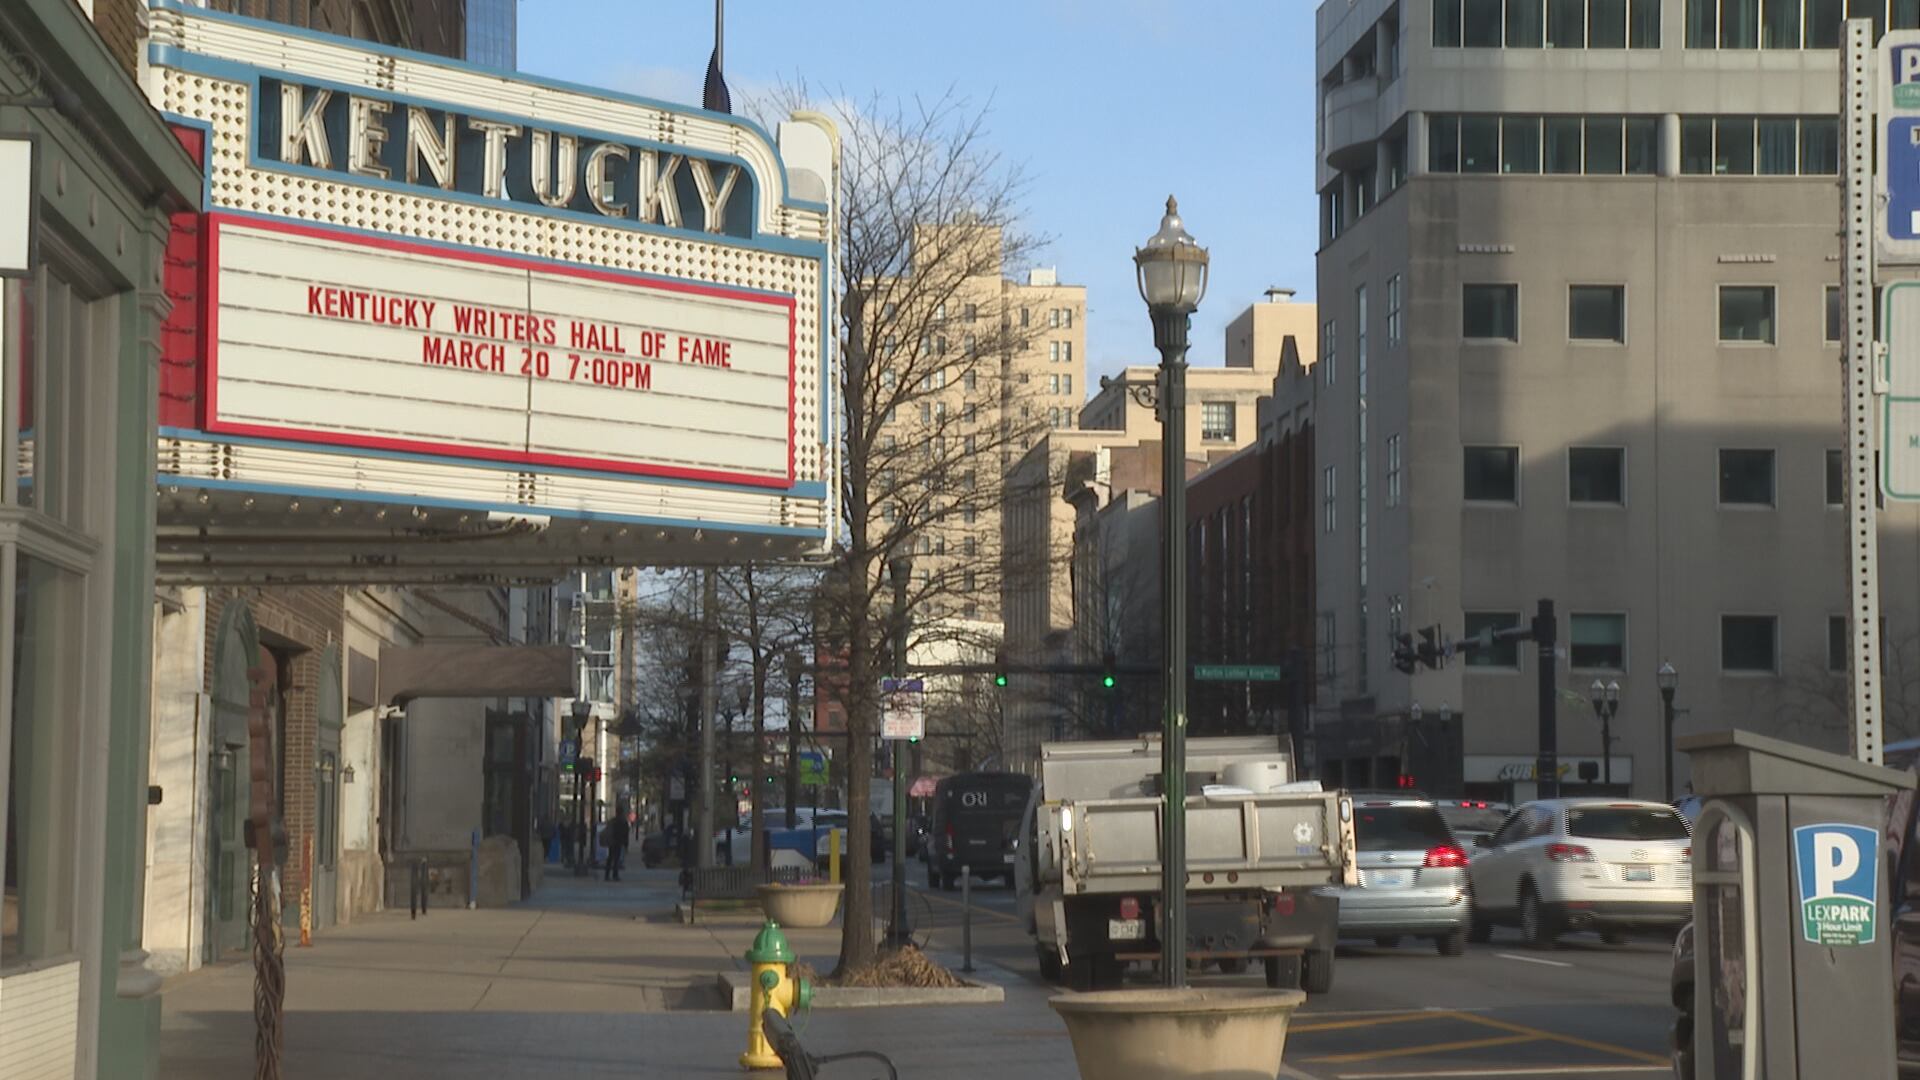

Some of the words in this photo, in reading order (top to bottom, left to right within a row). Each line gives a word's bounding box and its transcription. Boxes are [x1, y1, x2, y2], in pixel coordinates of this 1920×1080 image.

[280, 83, 742, 235] KENTUCKY
[306, 286, 436, 331] KENTUCKY
[452, 304, 558, 347] WRITERS
[569, 320, 626, 355] HALL
[640, 330, 666, 360] OF
[677, 335, 732, 369] FAME
[422, 334, 506, 374] MARCH
[519, 347, 550, 380] 20
[566, 353, 652, 390] 7:00PM
[1814, 831, 1859, 898] P
[1808, 904, 1870, 921] LEXPARK
[1822, 922, 1841, 931] Hour
[1843, 922, 1863, 932] Limit
